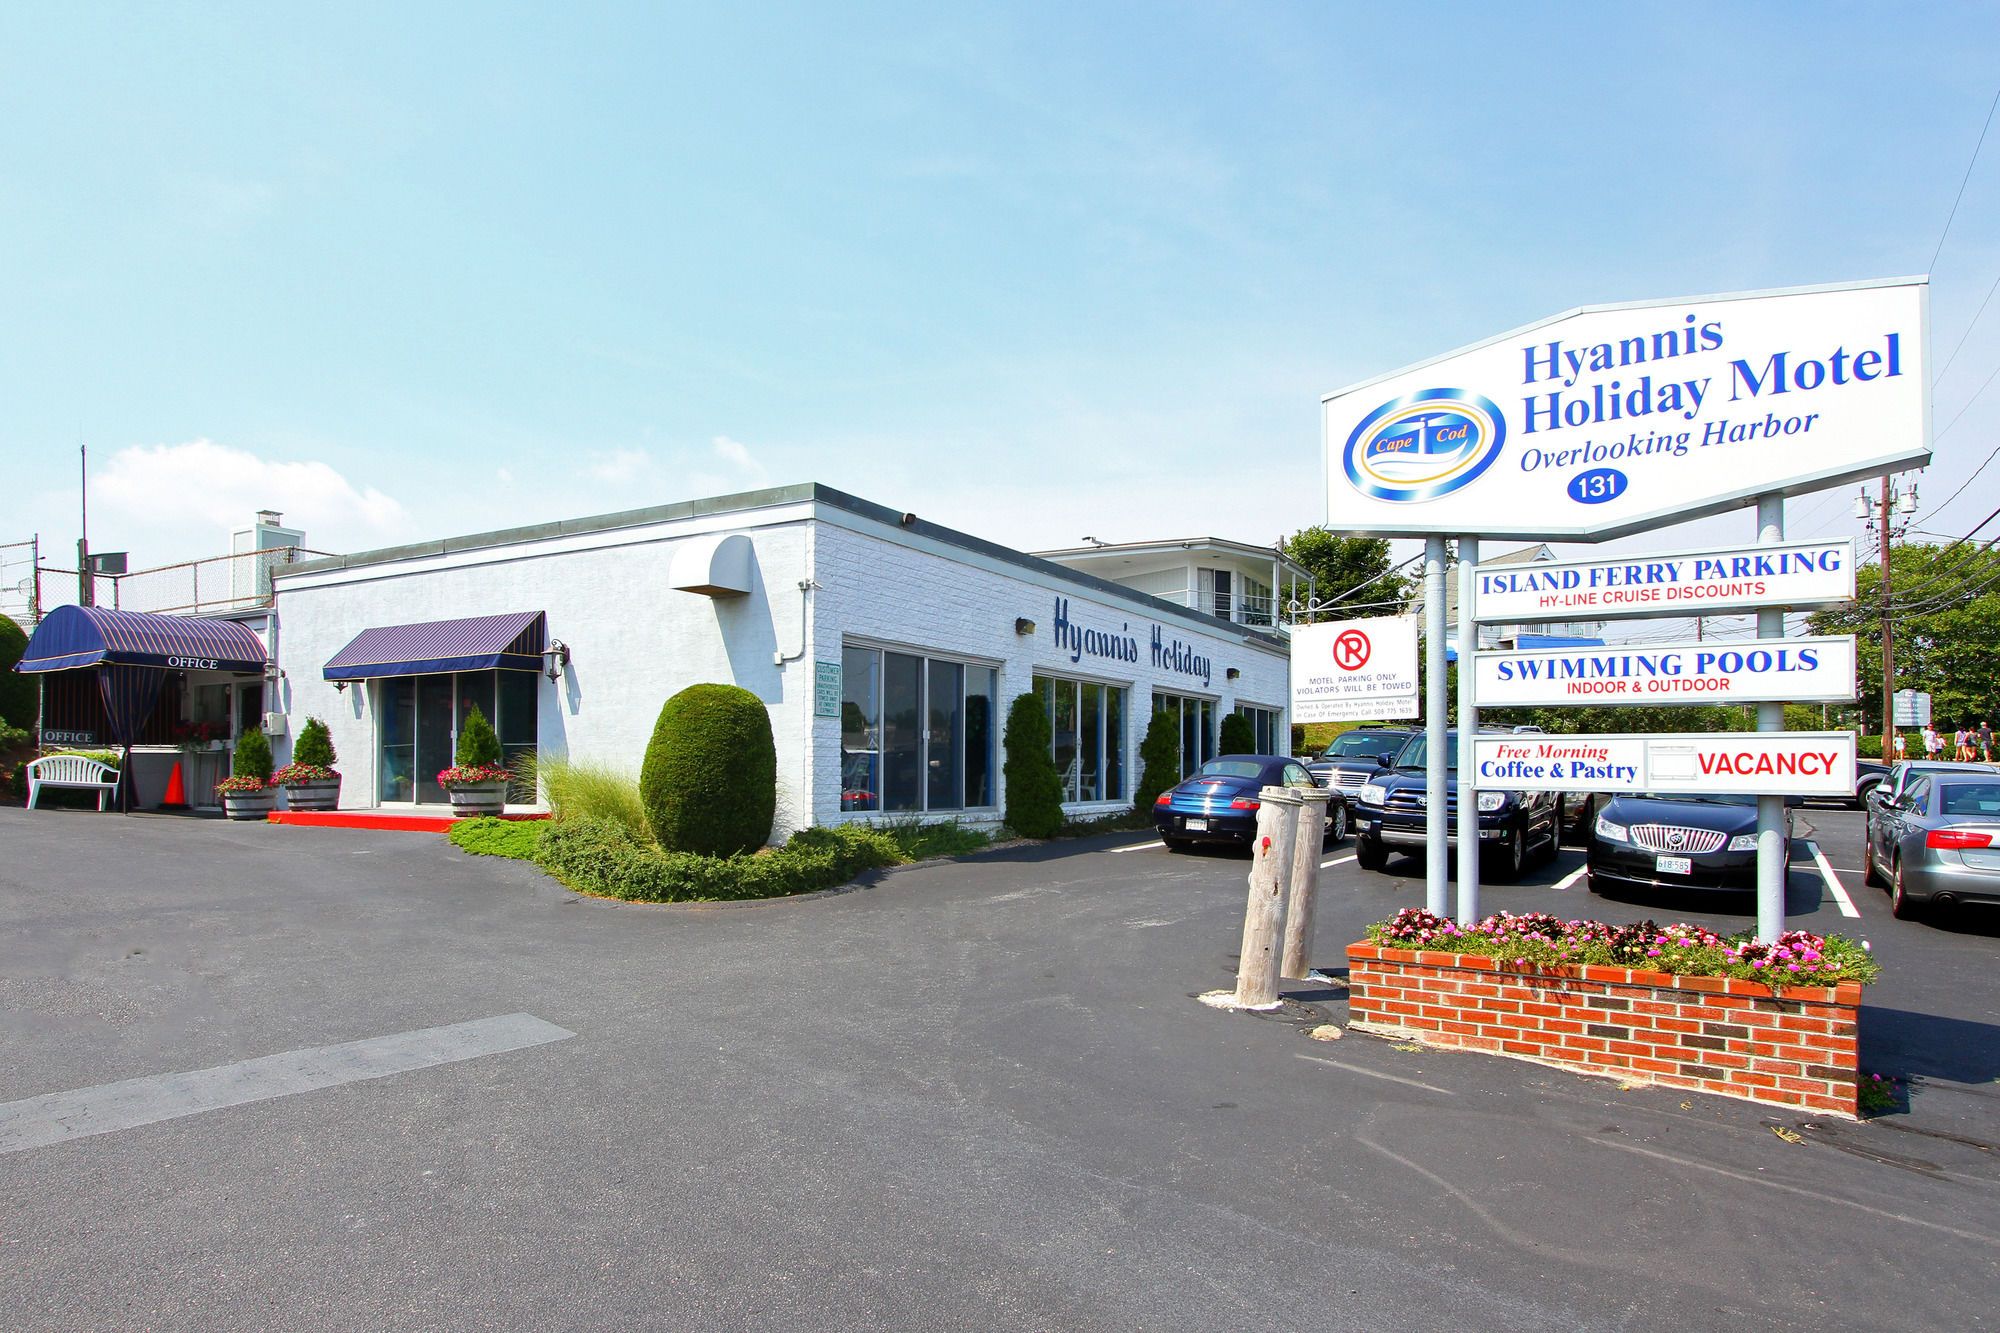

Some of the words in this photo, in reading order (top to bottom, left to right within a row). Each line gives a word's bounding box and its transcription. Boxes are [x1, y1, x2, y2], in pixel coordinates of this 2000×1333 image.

[1520, 314, 1723, 387] Hyannis
[1521, 375, 1712, 434] Holiday
[1727, 332, 1903, 401] Motel
[1375, 436, 1413, 454] Cape
[1436, 424, 1469, 442] Cod
[1520, 430, 1690, 472] Overlooking
[1700, 412, 1819, 447] Harbor
[1578, 474, 1617, 498] 131
[1481, 569, 1581, 595] ISLAND
[1588, 561, 1684, 588] FERRY
[1694, 549, 1841, 581] PARKING
[1539, 592, 1597, 608] HY-LINE
[1602, 588, 1660, 604] CRUISE
[1666, 581, 1766, 600] DISCOUNTS
[1054, 596, 1138, 663] Hyannis
[1151, 623, 1211, 687] Holiday
[167, 656, 218, 670] OFFICE
[1497, 653, 1682, 682] SWIMMING
[1694, 648, 1818, 676] POOLS
[1296, 685, 1340, 695] VIOLATORS
[1344, 685, 1363, 693] WILL
[1366, 683, 1377, 691] BE
[1382, 681, 1412, 690] TOWED
[1309, 677, 1333, 685] MOTEL
[1338, 674, 1372, 683] PARKING
[1376, 673, 1397, 681] ONLY
[1567, 680, 1626, 695] INDOOR
[1632, 680, 1642, 693] &
[1647, 677, 1730, 693] OUTDOOR
[45, 730, 93, 743] OFFICE
[1496, 744, 1531, 760] Free
[1535, 744, 1609, 762] Morning
[1698, 752, 1838, 776] VACANCY
[1480, 760, 1545, 779] Coffee
[1550, 762, 1564, 779] &
[1570, 761, 1638, 783] Pastry
